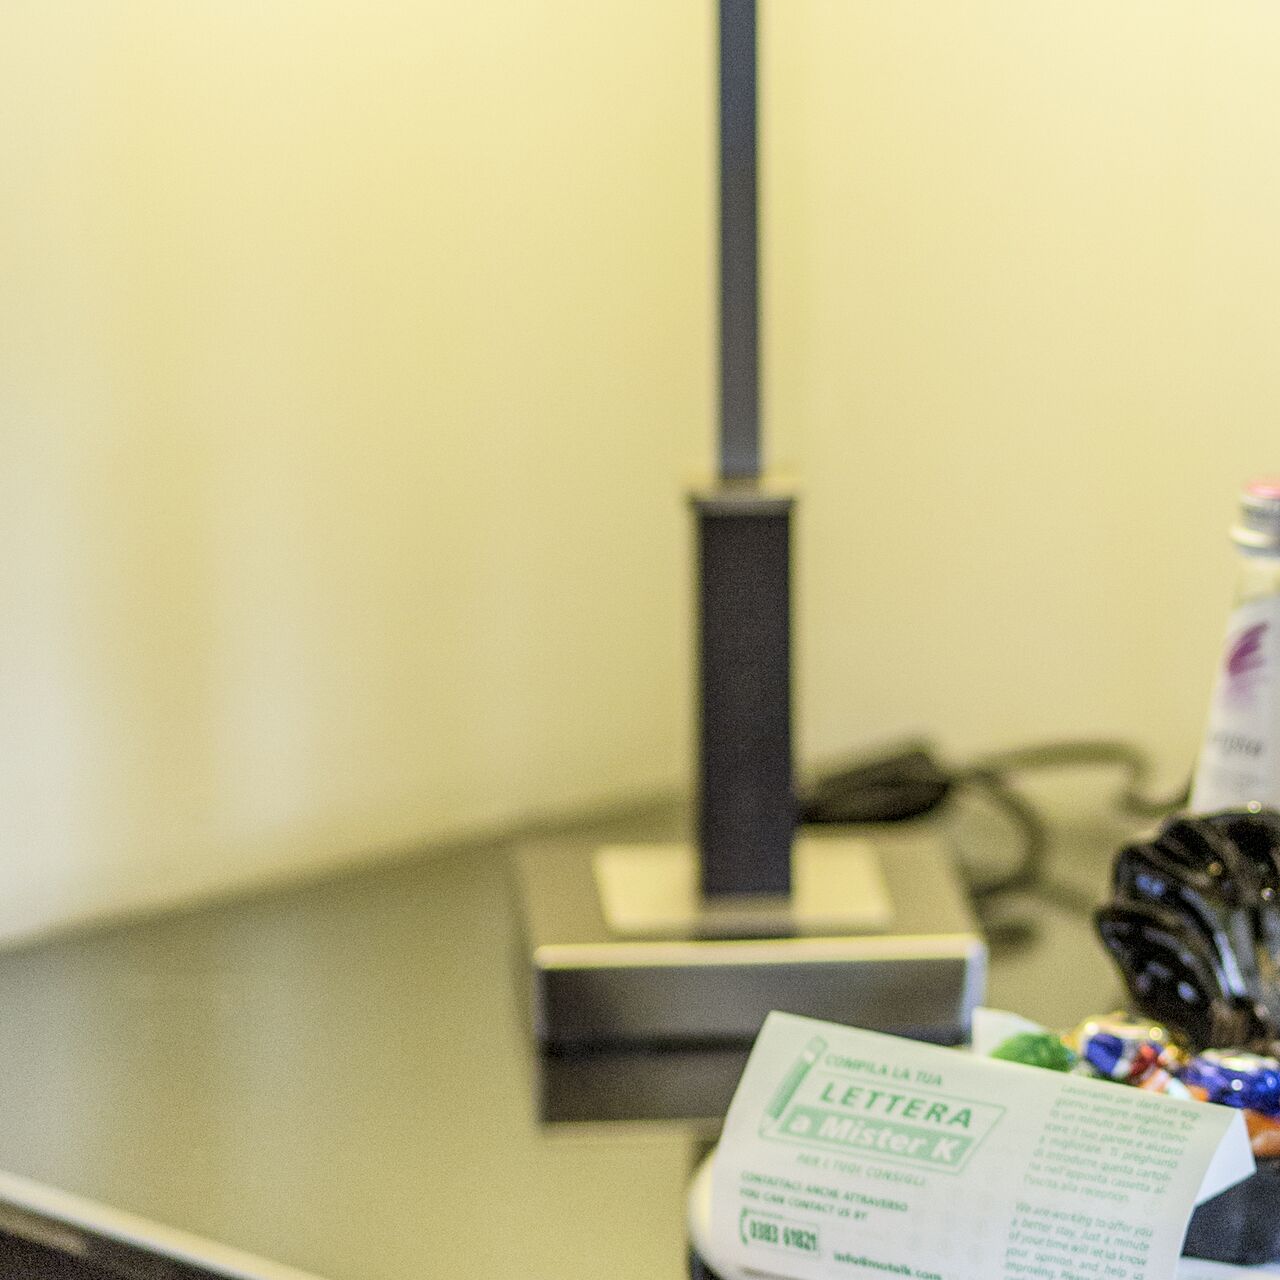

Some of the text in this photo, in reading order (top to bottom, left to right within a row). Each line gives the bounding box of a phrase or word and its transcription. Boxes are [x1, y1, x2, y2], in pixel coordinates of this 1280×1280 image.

[824, 1053, 944, 1087] COMPILA LA TUA
[820, 1082, 973, 1130] LETTERA
[789, 1115, 959, 1161] a Mister K
[797, 1152, 820, 1168] PER
[866, 1165, 927, 1187] CONSIGLI
[764, 1194, 785, 1205] CAN
[788, 1199, 834, 1213] CONTACT
[837, 1208, 850, 1218] US
[853, 1210, 867, 1220] BY
[805, 1185, 839, 1199] ANCHE
[843, 1192, 908, 1212] ATTRAVERSO
[1015, 1201, 1032, 1214] We
[1052, 1211, 1093, 1227] working
[1095, 1218, 1106, 1228] to
[1107, 1221, 1133, 1233] offer
[1134, 1227, 1154, 1238] you
[1021, 1218, 1053, 1233] better
[1114, 1238, 1150, 1252] minute
[1007, 1247, 1028, 1258] your
[1078, 1261, 1100, 1273] and
[1104, 1265, 1127, 1278] help
[1009, 1231, 1021, 1241] of
[1020, 1235, 1045, 1246] your
[1046, 1238, 1069, 1251] time
[1070, 1244, 1089, 1254] will
[1105, 1251, 1117, 1261] us
[1118, 1253, 1148, 1267] know
